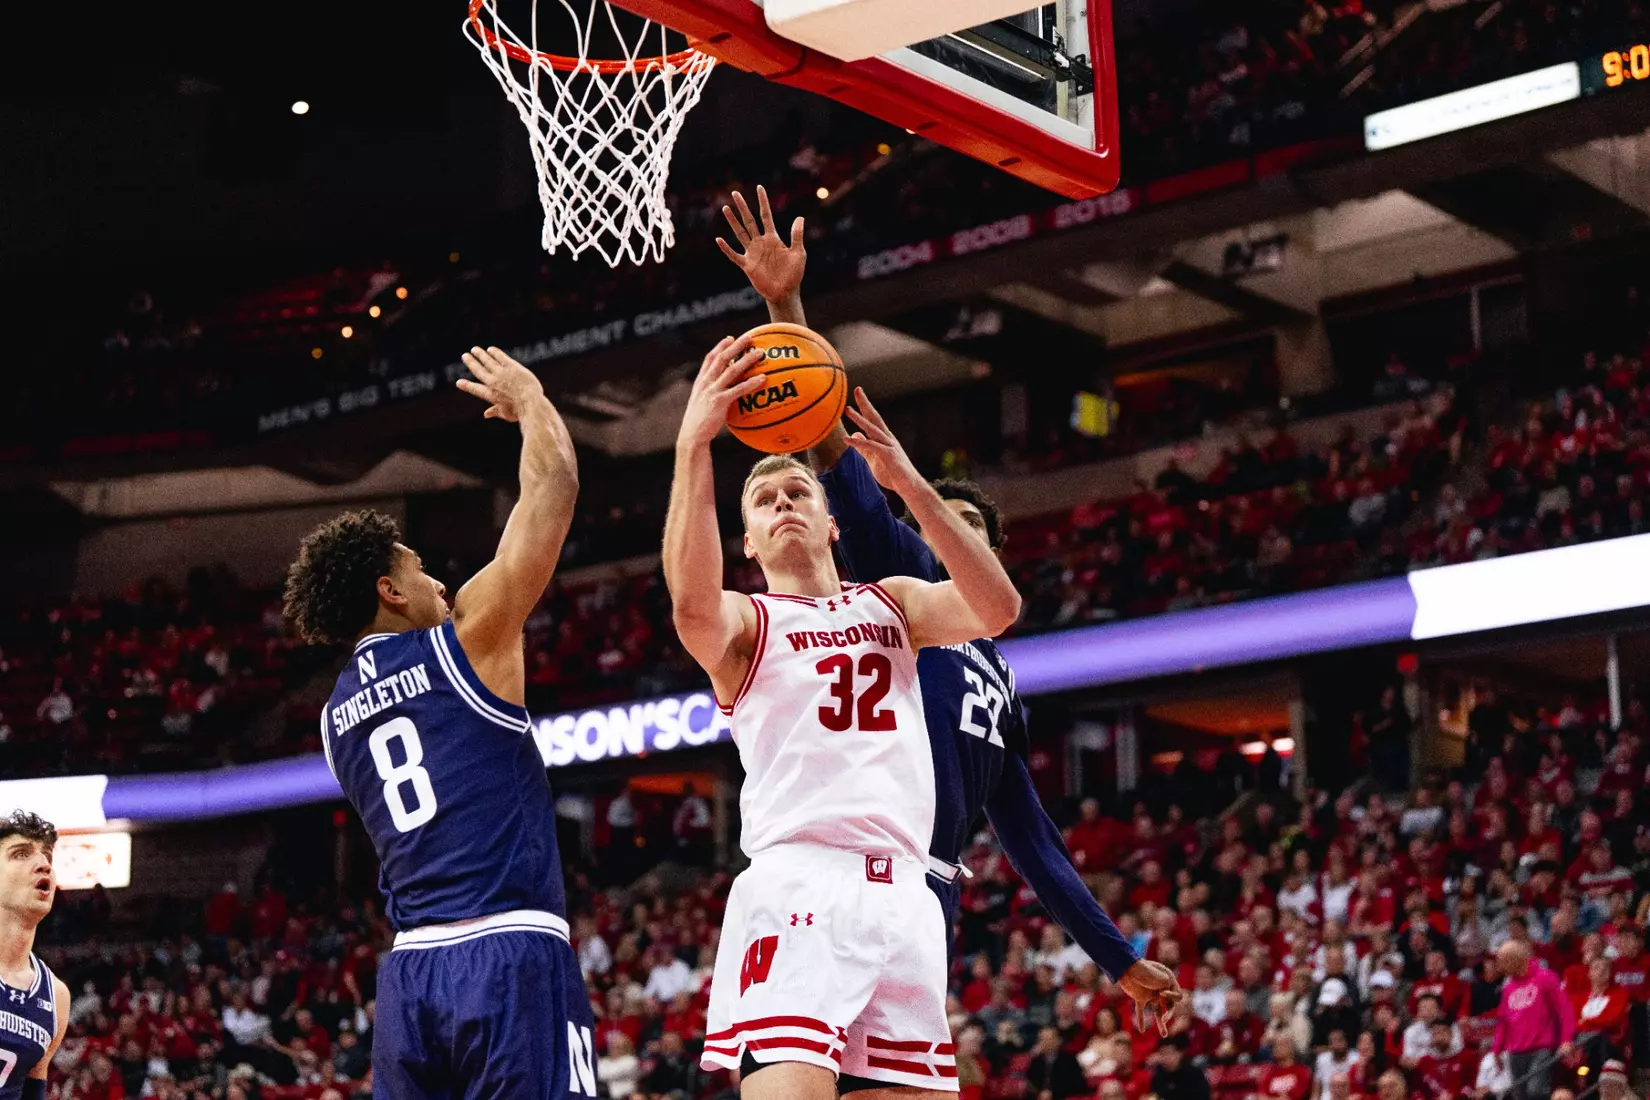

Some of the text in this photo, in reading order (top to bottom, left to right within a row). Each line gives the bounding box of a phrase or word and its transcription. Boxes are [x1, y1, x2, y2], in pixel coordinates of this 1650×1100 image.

[1603, 44, 1650, 87] 9:0
[387, 370, 436, 400] TEN
[736, 380, 799, 416] NCAA
[786, 622, 903, 652] WISCONSIN
[357, 650, 377, 685] N
[332, 663, 432, 737] SINGLETON
[815, 653, 897, 732] 32
[368, 716, 438, 833] 8
[567, 1020, 597, 1098] N
